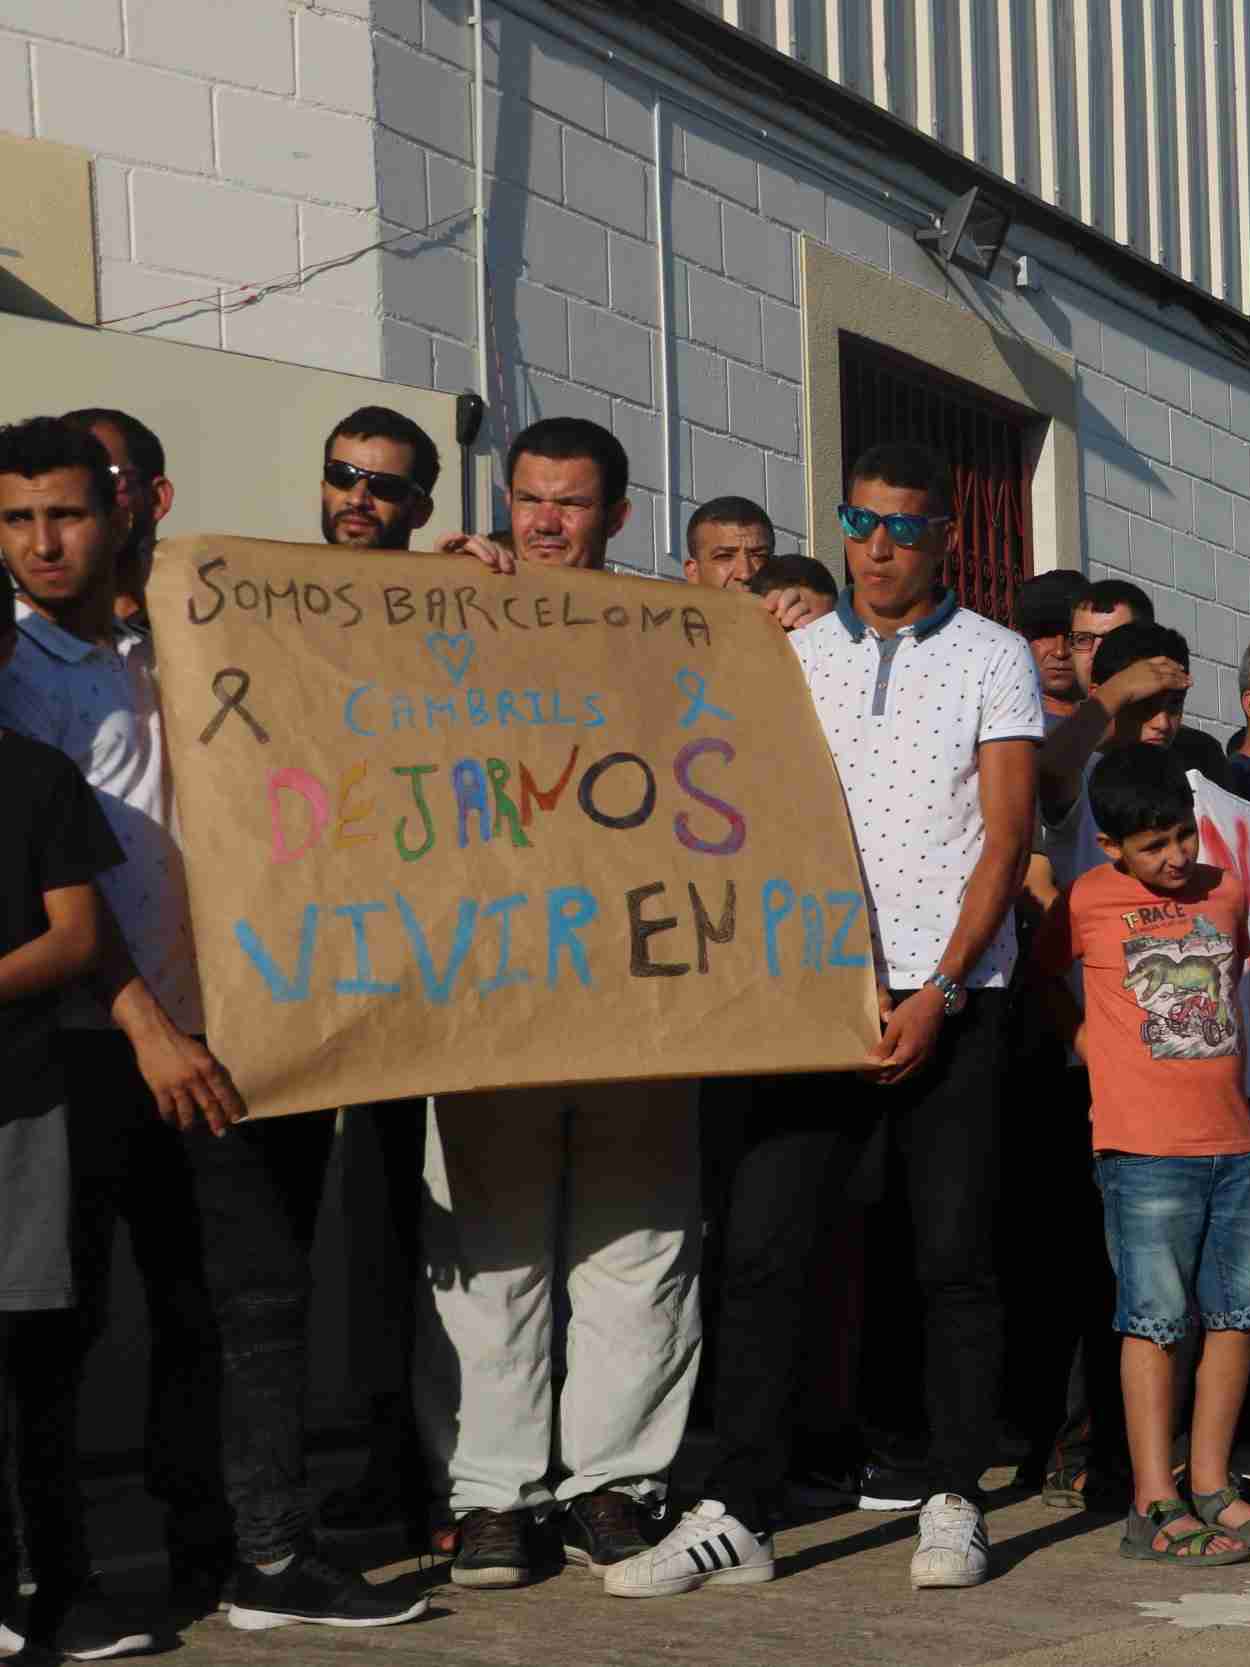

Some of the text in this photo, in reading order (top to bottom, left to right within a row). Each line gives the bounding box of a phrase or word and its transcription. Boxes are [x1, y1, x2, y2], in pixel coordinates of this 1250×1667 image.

[188, 556, 712, 648] SOMOS BARCELONA
[344, 682, 607, 737] CAMBRILS
[266, 736, 747, 865] DEJARNOS
[233, 878, 870, 1004] VIVIR EN PAZ
